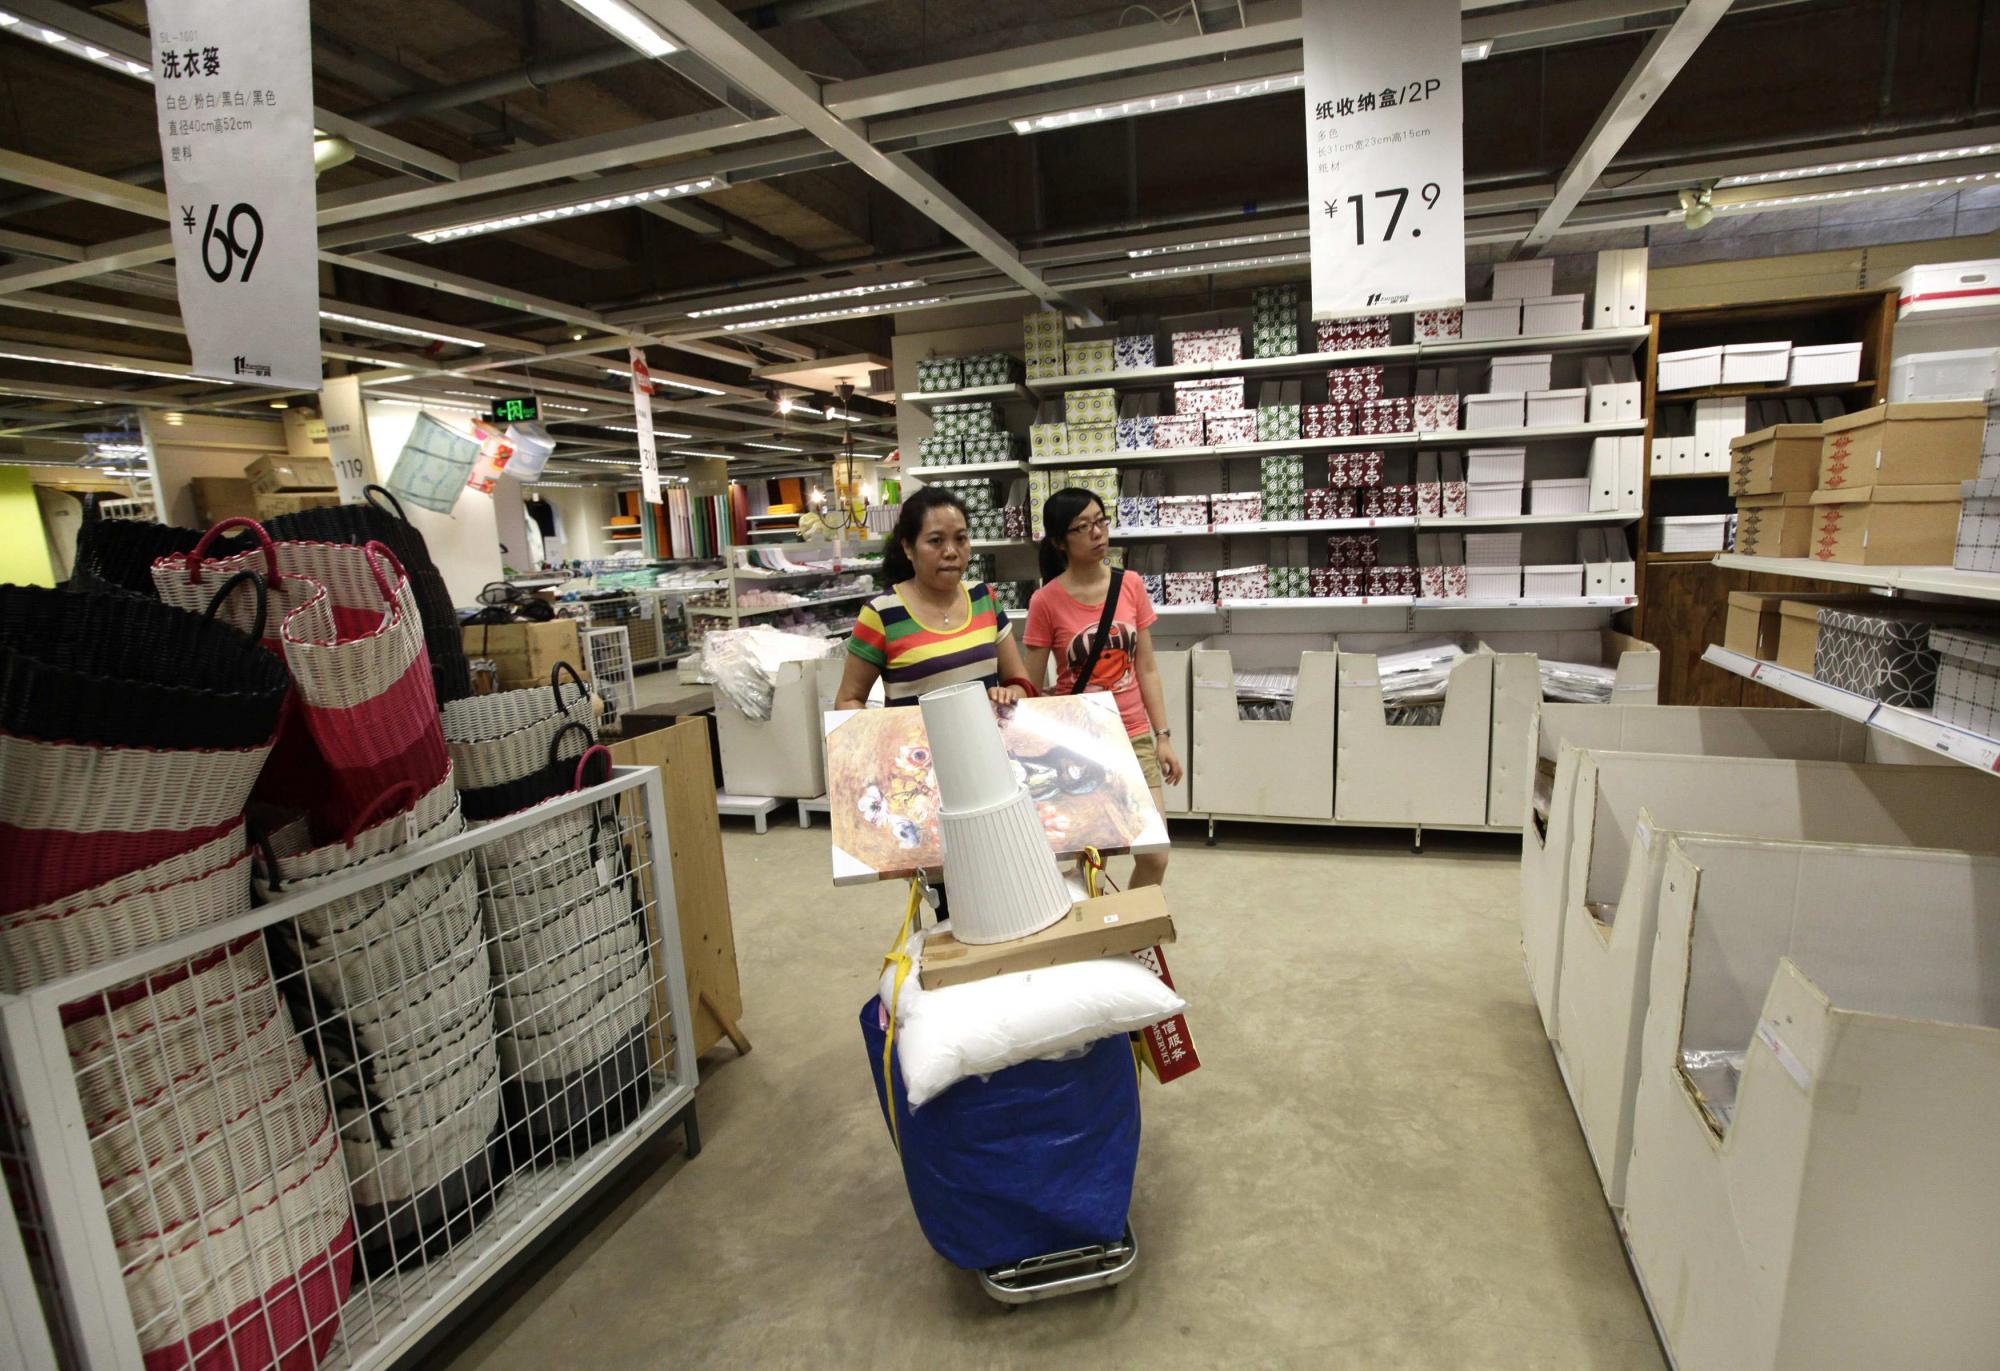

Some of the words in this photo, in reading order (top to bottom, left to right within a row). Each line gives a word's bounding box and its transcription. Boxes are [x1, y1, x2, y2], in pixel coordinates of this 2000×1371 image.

[161, 46, 221, 79] 洗衣篓
[166, 89, 277, 111] 白色/粉白/黑白/黑色
[1315, 78, 1441, 121] 纸收纳盒/2P
[168, 117, 252, 137] 直径40cm高52cm
